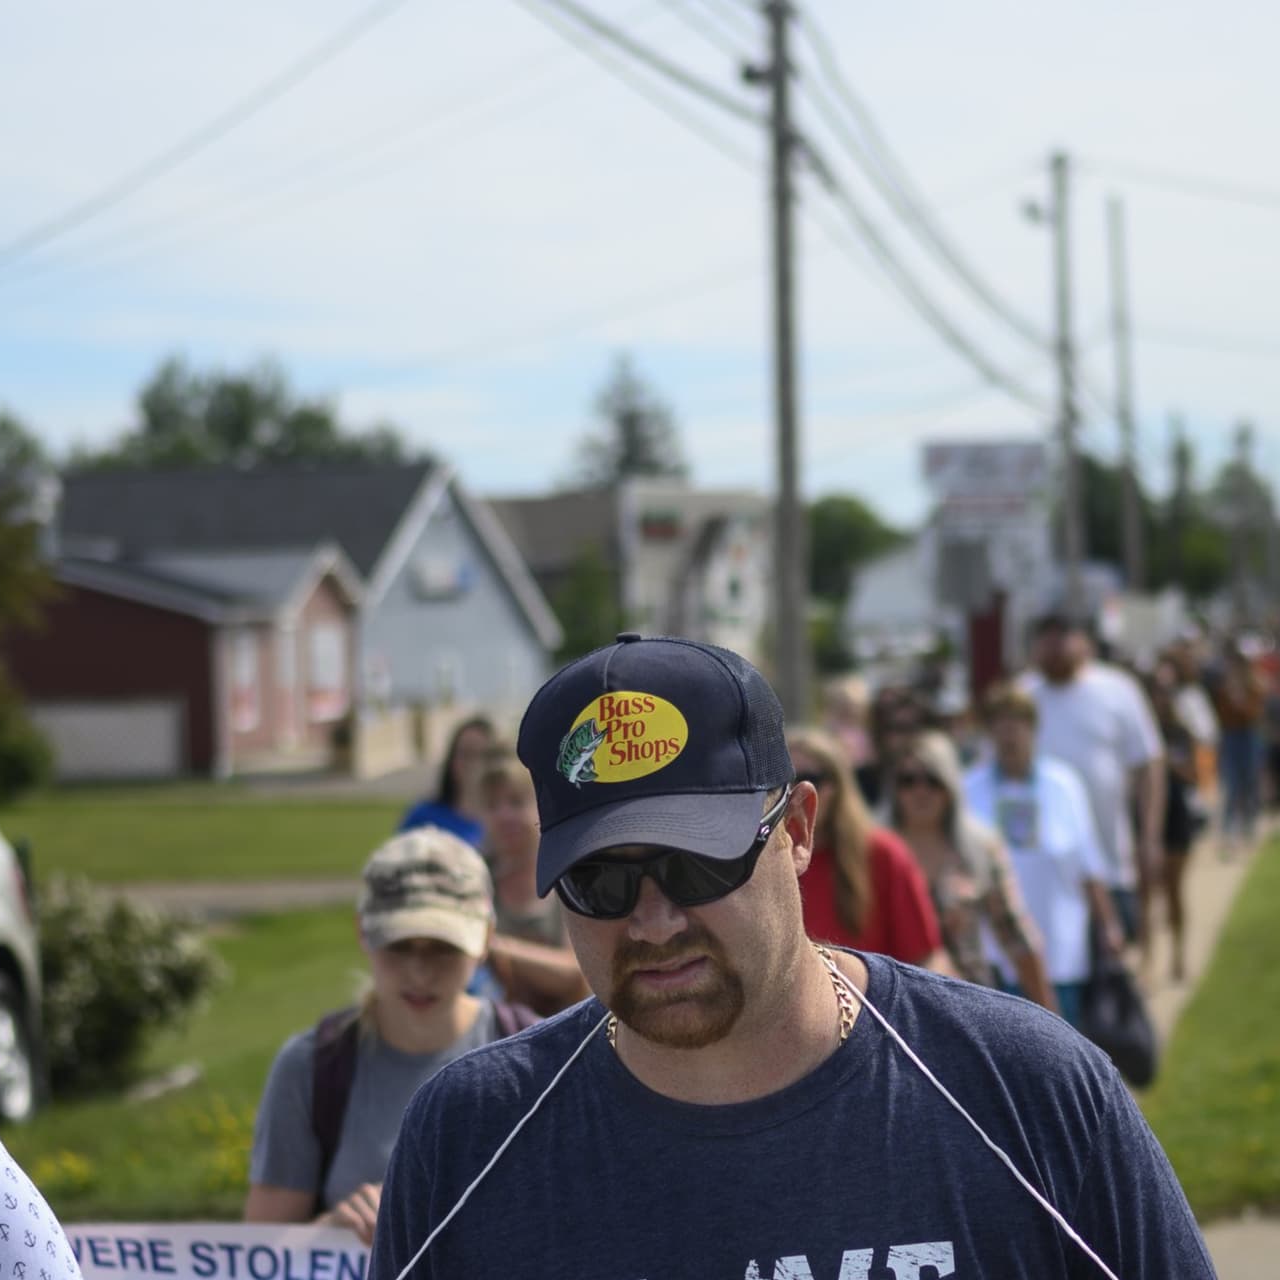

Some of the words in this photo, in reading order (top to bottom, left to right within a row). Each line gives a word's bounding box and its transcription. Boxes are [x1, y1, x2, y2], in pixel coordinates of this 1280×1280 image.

[598, 695, 656, 722] Bass
[605, 718, 646, 744] Pro
[608, 737, 680, 766] Shops
